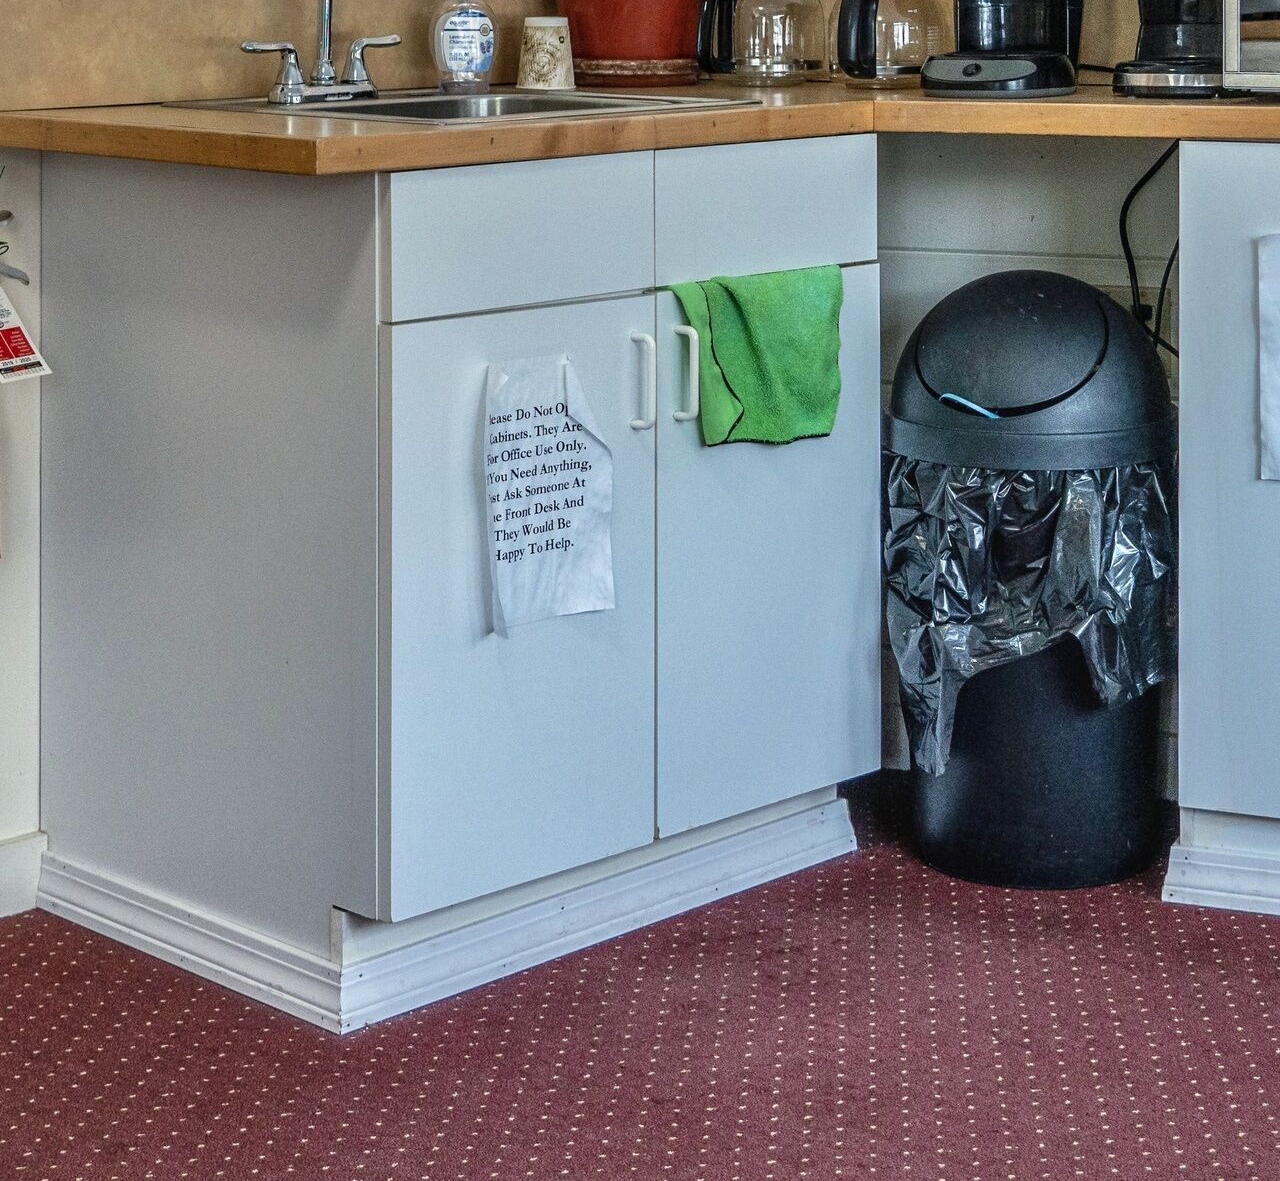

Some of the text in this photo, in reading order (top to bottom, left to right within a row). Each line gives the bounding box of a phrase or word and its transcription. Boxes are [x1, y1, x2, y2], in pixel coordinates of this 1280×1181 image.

[516, 409, 530, 420] Do
[534, 406, 553, 417] Not
[534, 425, 559, 437] They
[562, 421, 583, 432] Are
[501, 448, 532, 462] Office
[535, 444, 553, 456] Use
[556, 440, 587, 453] Only.
[488, 472, 507, 485] You
[510, 464, 537, 480] Need
[540, 459, 592, 476] Anything,
[504, 488, 522, 501] Ask
[525, 482, 569, 497] Someone
[572, 477, 586, 488] At
[505, 507, 531, 521] Front
[534, 500, 560, 514] Desk
[563, 495, 584, 509] And
[494, 517, 571, 542] They Would Be
[528, 542, 543, 555] To
[545, 538, 574, 551] Help.
